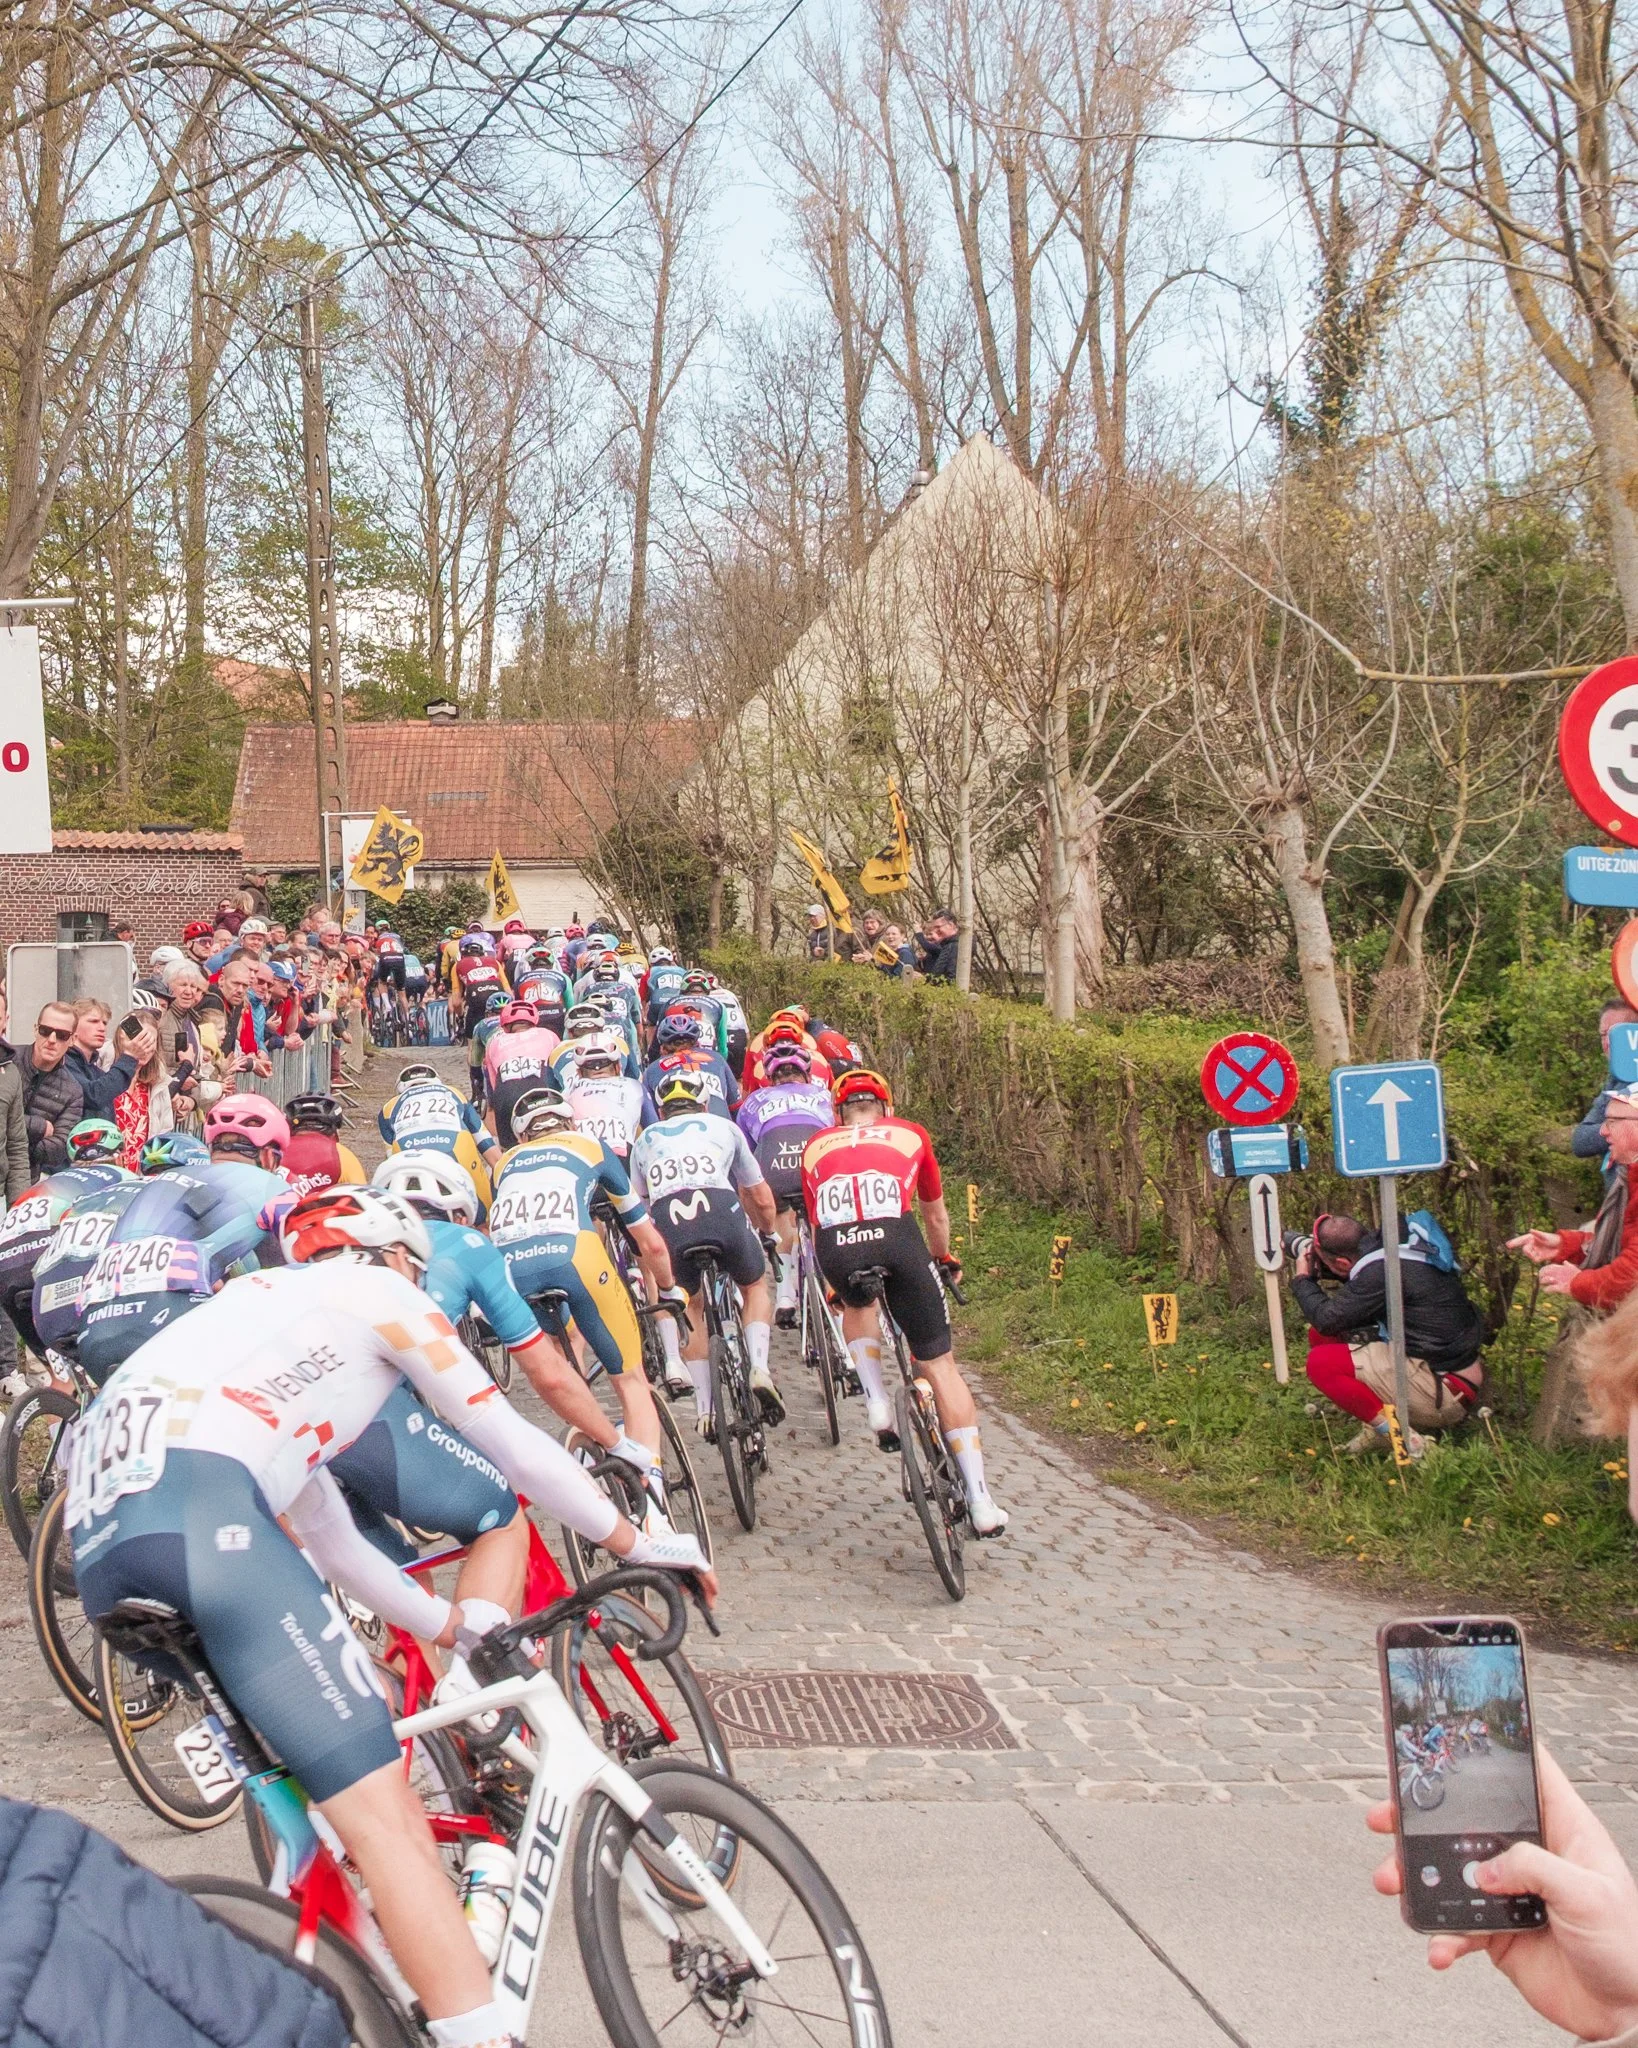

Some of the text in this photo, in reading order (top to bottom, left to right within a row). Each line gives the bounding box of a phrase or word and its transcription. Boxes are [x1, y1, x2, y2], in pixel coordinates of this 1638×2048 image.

[1577, 856, 1638, 873] UITGEZON
[612, 999, 626, 1011] 23
[501, 1059, 520, 1075] 43
[427, 1098, 456, 1117] 222
[761, 1097, 784, 1116] 137
[413, 1133, 450, 1146] baloise
[576, 1119, 626, 1141] 13 213
[515, 1151, 568, 1168] baloise
[649, 1155, 716, 1187] 93 93
[292, 1172, 332, 1196] Cofidis
[818, 1178, 900, 1215] 164 164
[19, 1198, 49, 1224] 33
[491, 1196, 529, 1232] 224
[534, 1190, 575, 1221] 224
[123, 1240, 173, 1275] 246
[515, 1242, 569, 1261] baloise
[87, 1301, 147, 1324] UNIBET
[254, 1344, 346, 1403] VENDÉE
[102, 1397, 163, 1473] 237
[427, 1424, 508, 1491] Groupama
[279, 1611, 353, 1720] TotalEnergies
[194, 1671, 237, 1728] CUBE
[182, 1733, 234, 1790] 237
[502, 1786, 568, 2001] CUBE
